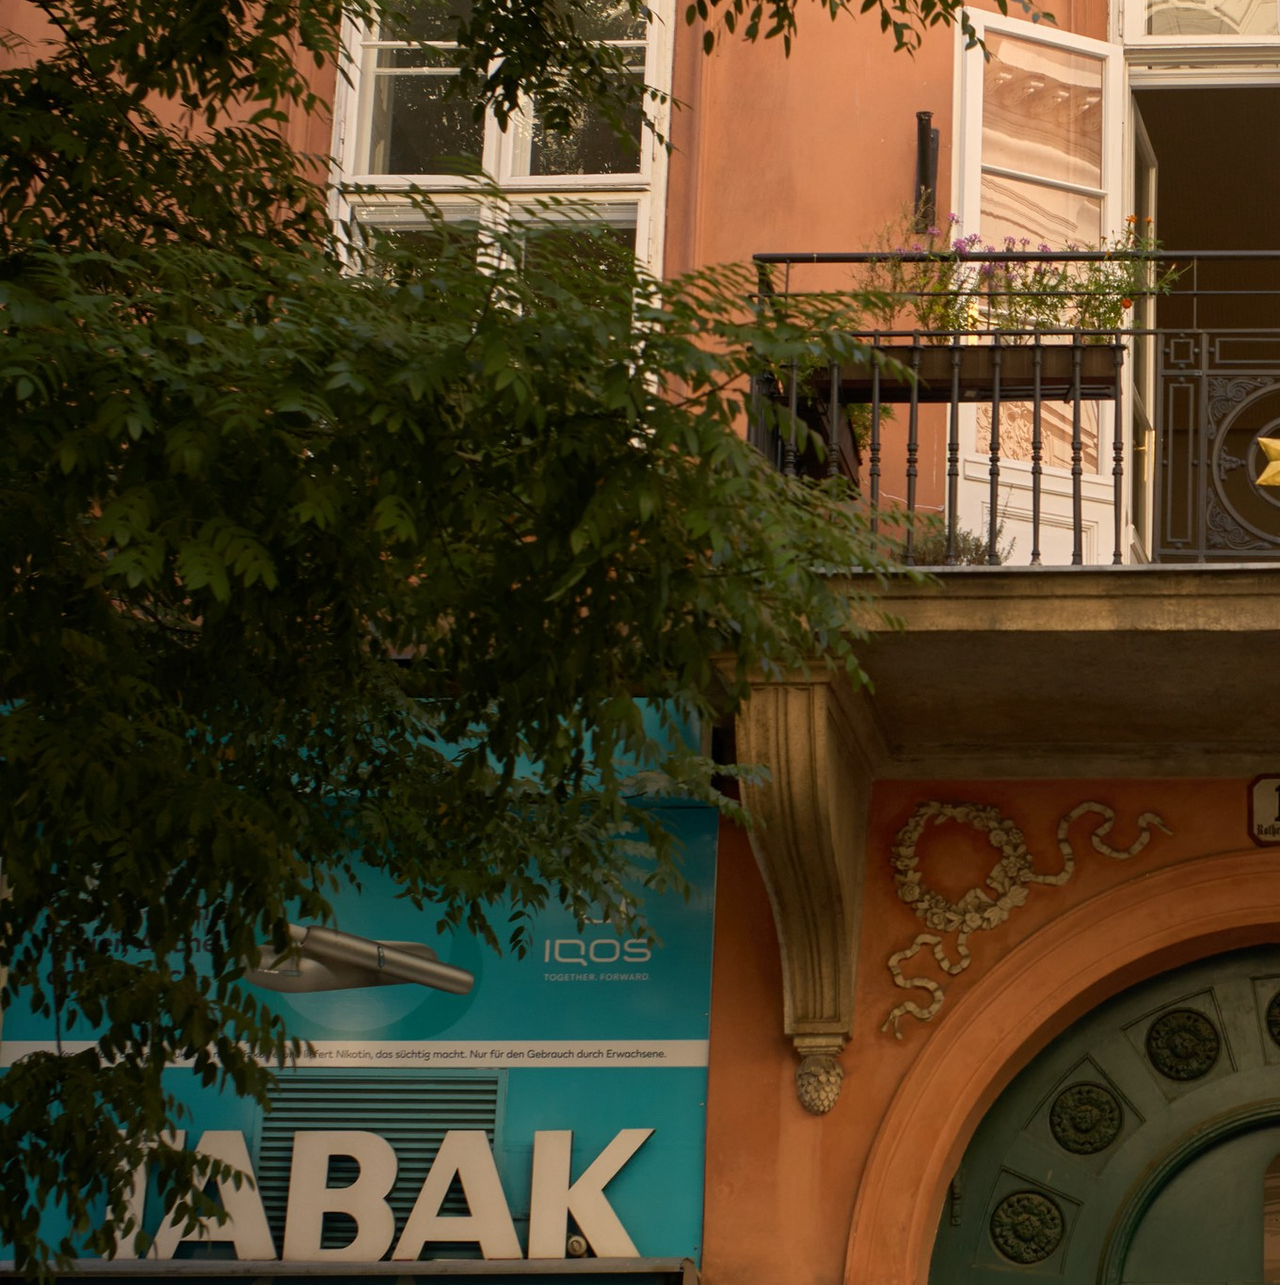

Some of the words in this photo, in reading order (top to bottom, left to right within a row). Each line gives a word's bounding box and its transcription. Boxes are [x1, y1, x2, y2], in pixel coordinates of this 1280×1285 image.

[543, 938, 651, 966] IQOS
[543, 973, 597, 982] TOGETHER.
[598, 973, 651, 982] FORWARD.
[335, 1047, 374, 1061] Nikotin,
[375, 1047, 394, 1060] das
[395, 1047, 431, 1062] süchtig
[432, 1047, 468, 1060] macht.
[469, 1047, 488, 1060] Nur
[489, 1046, 505, 1060] für
[506, 1046, 525, 1060] den
[527, 1046, 576, 1060] Gebrauch
[576, 1046, 605, 1060] durch
[606, 1046, 668, 1060] Erwachsene.
